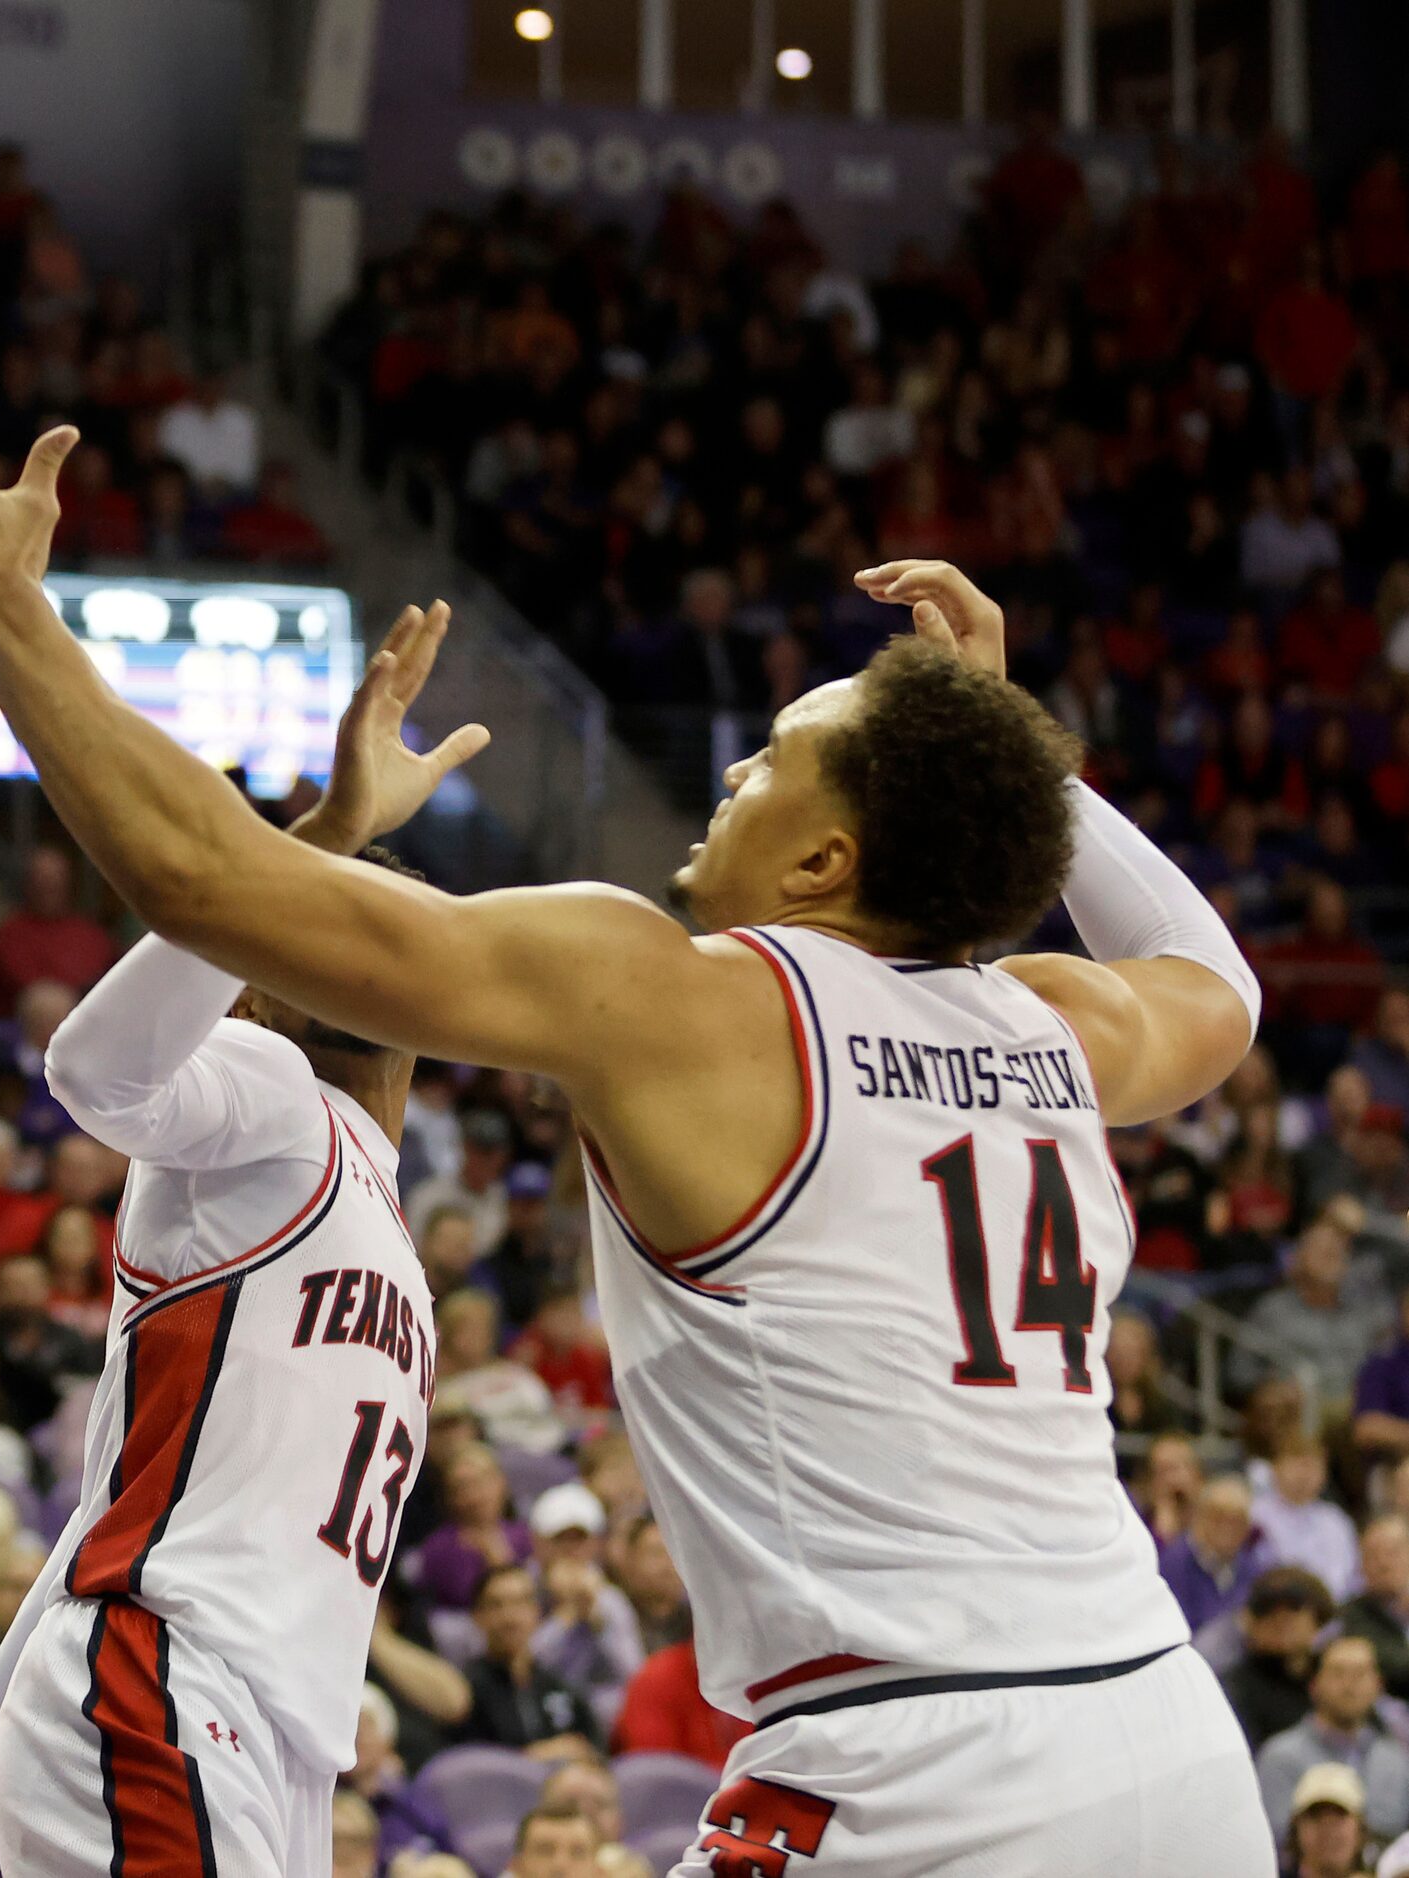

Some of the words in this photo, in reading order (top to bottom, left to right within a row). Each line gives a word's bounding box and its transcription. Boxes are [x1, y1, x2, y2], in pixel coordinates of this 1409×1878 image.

[291, 1268, 414, 1374] TEXAS
[920, 1132, 1097, 1394] 14
[316, 1400, 415, 1588] 13
